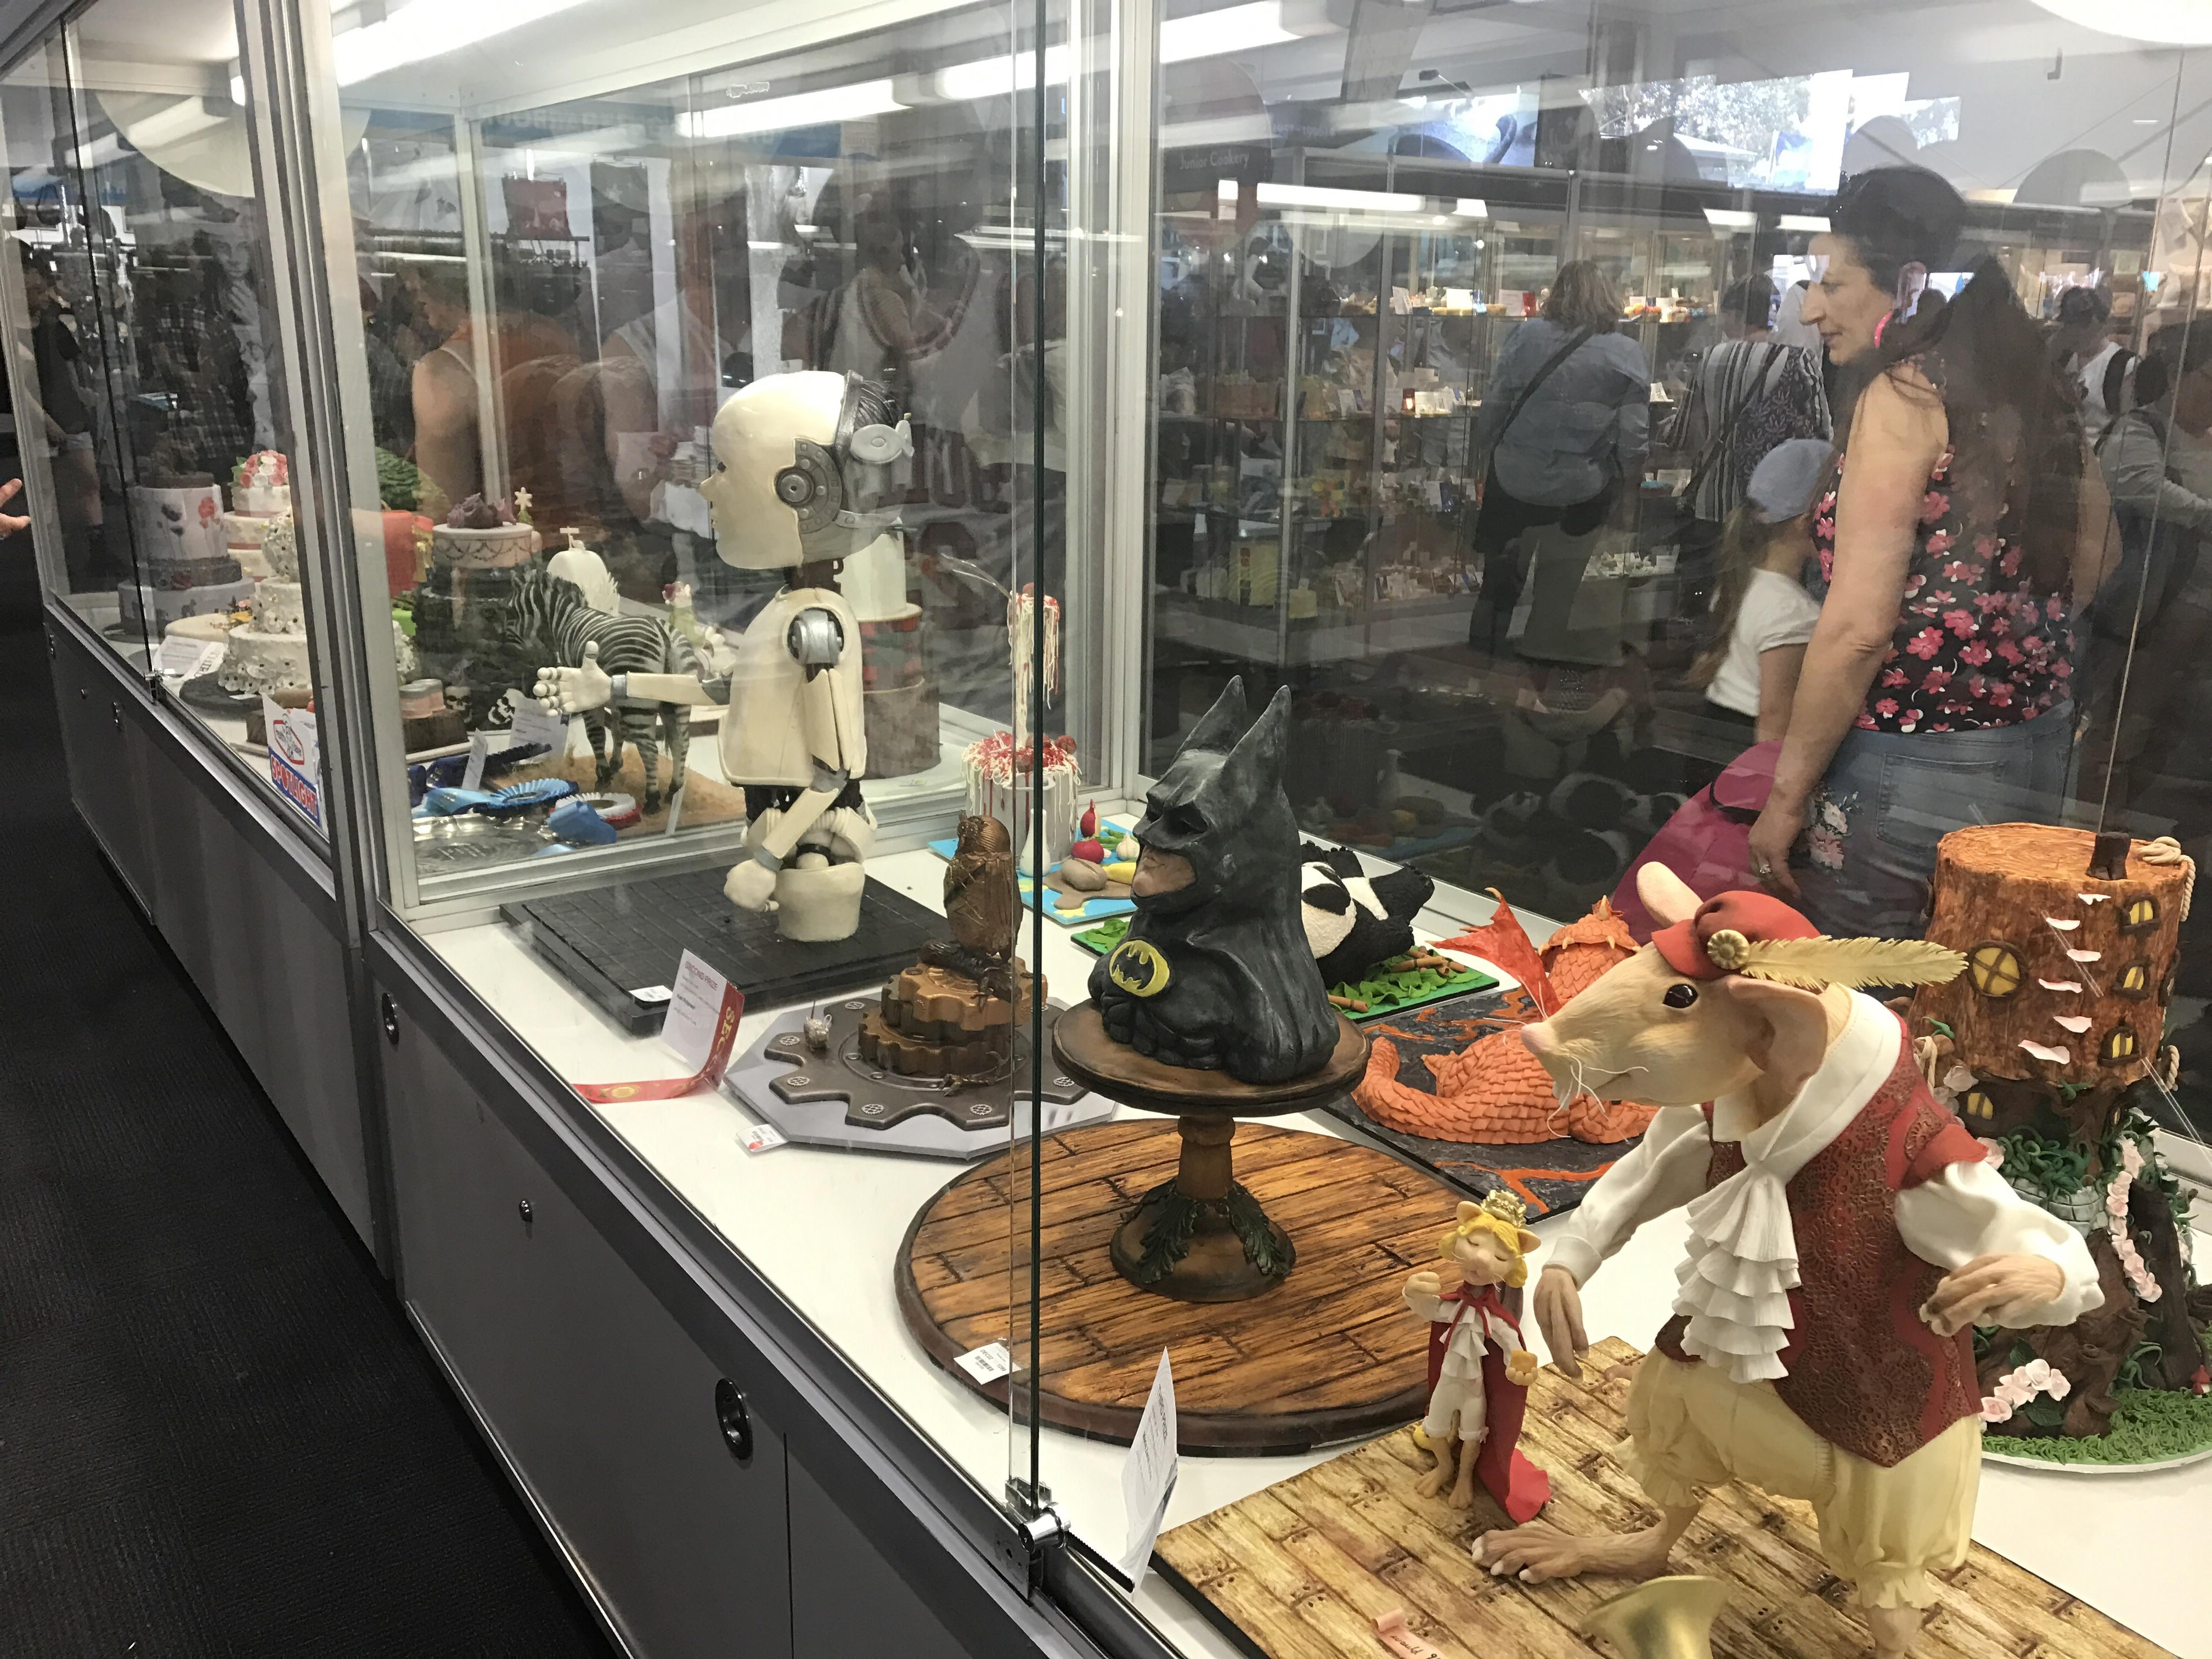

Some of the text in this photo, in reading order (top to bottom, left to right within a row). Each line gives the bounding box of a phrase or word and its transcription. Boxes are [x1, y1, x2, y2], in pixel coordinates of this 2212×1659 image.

[1180, 149, 1250, 170] Junior Cookery
[271, 754, 318, 819] SPOTLIGHT
[685, 961, 704, 980] SECOND
[704, 975, 718, 991] PRIZE
[1390, 1635, 1424, 1655] would
